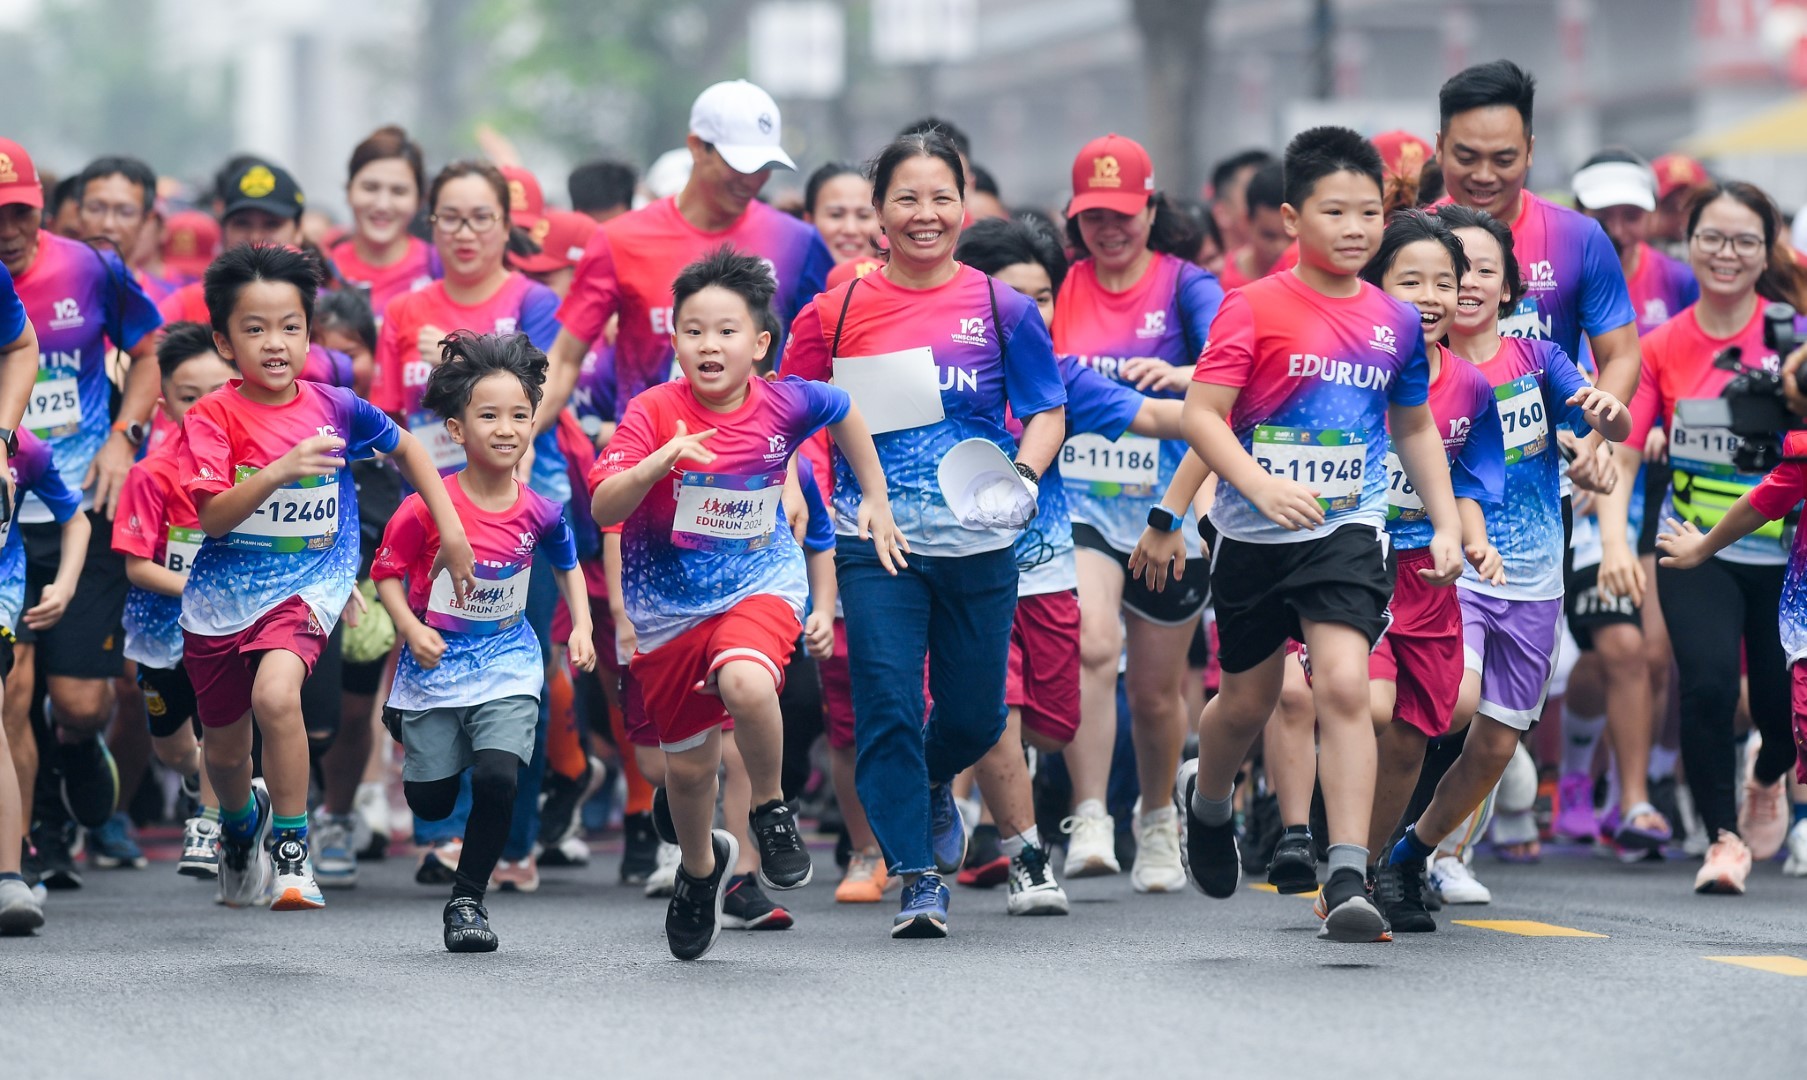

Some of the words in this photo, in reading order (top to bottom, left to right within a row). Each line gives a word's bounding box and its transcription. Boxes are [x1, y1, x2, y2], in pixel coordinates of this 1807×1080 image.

[951, 333, 988, 344] VINSCHOOL
[1288, 353, 1391, 392] EDURUN
[1063, 445, 1154, 471] B-11186
[1257, 456, 1363, 483] B-11948
[695, 515, 743, 531] EDURUN
[743, 518, 763, 531] 2024
[494, 601, 514, 613] 2024
